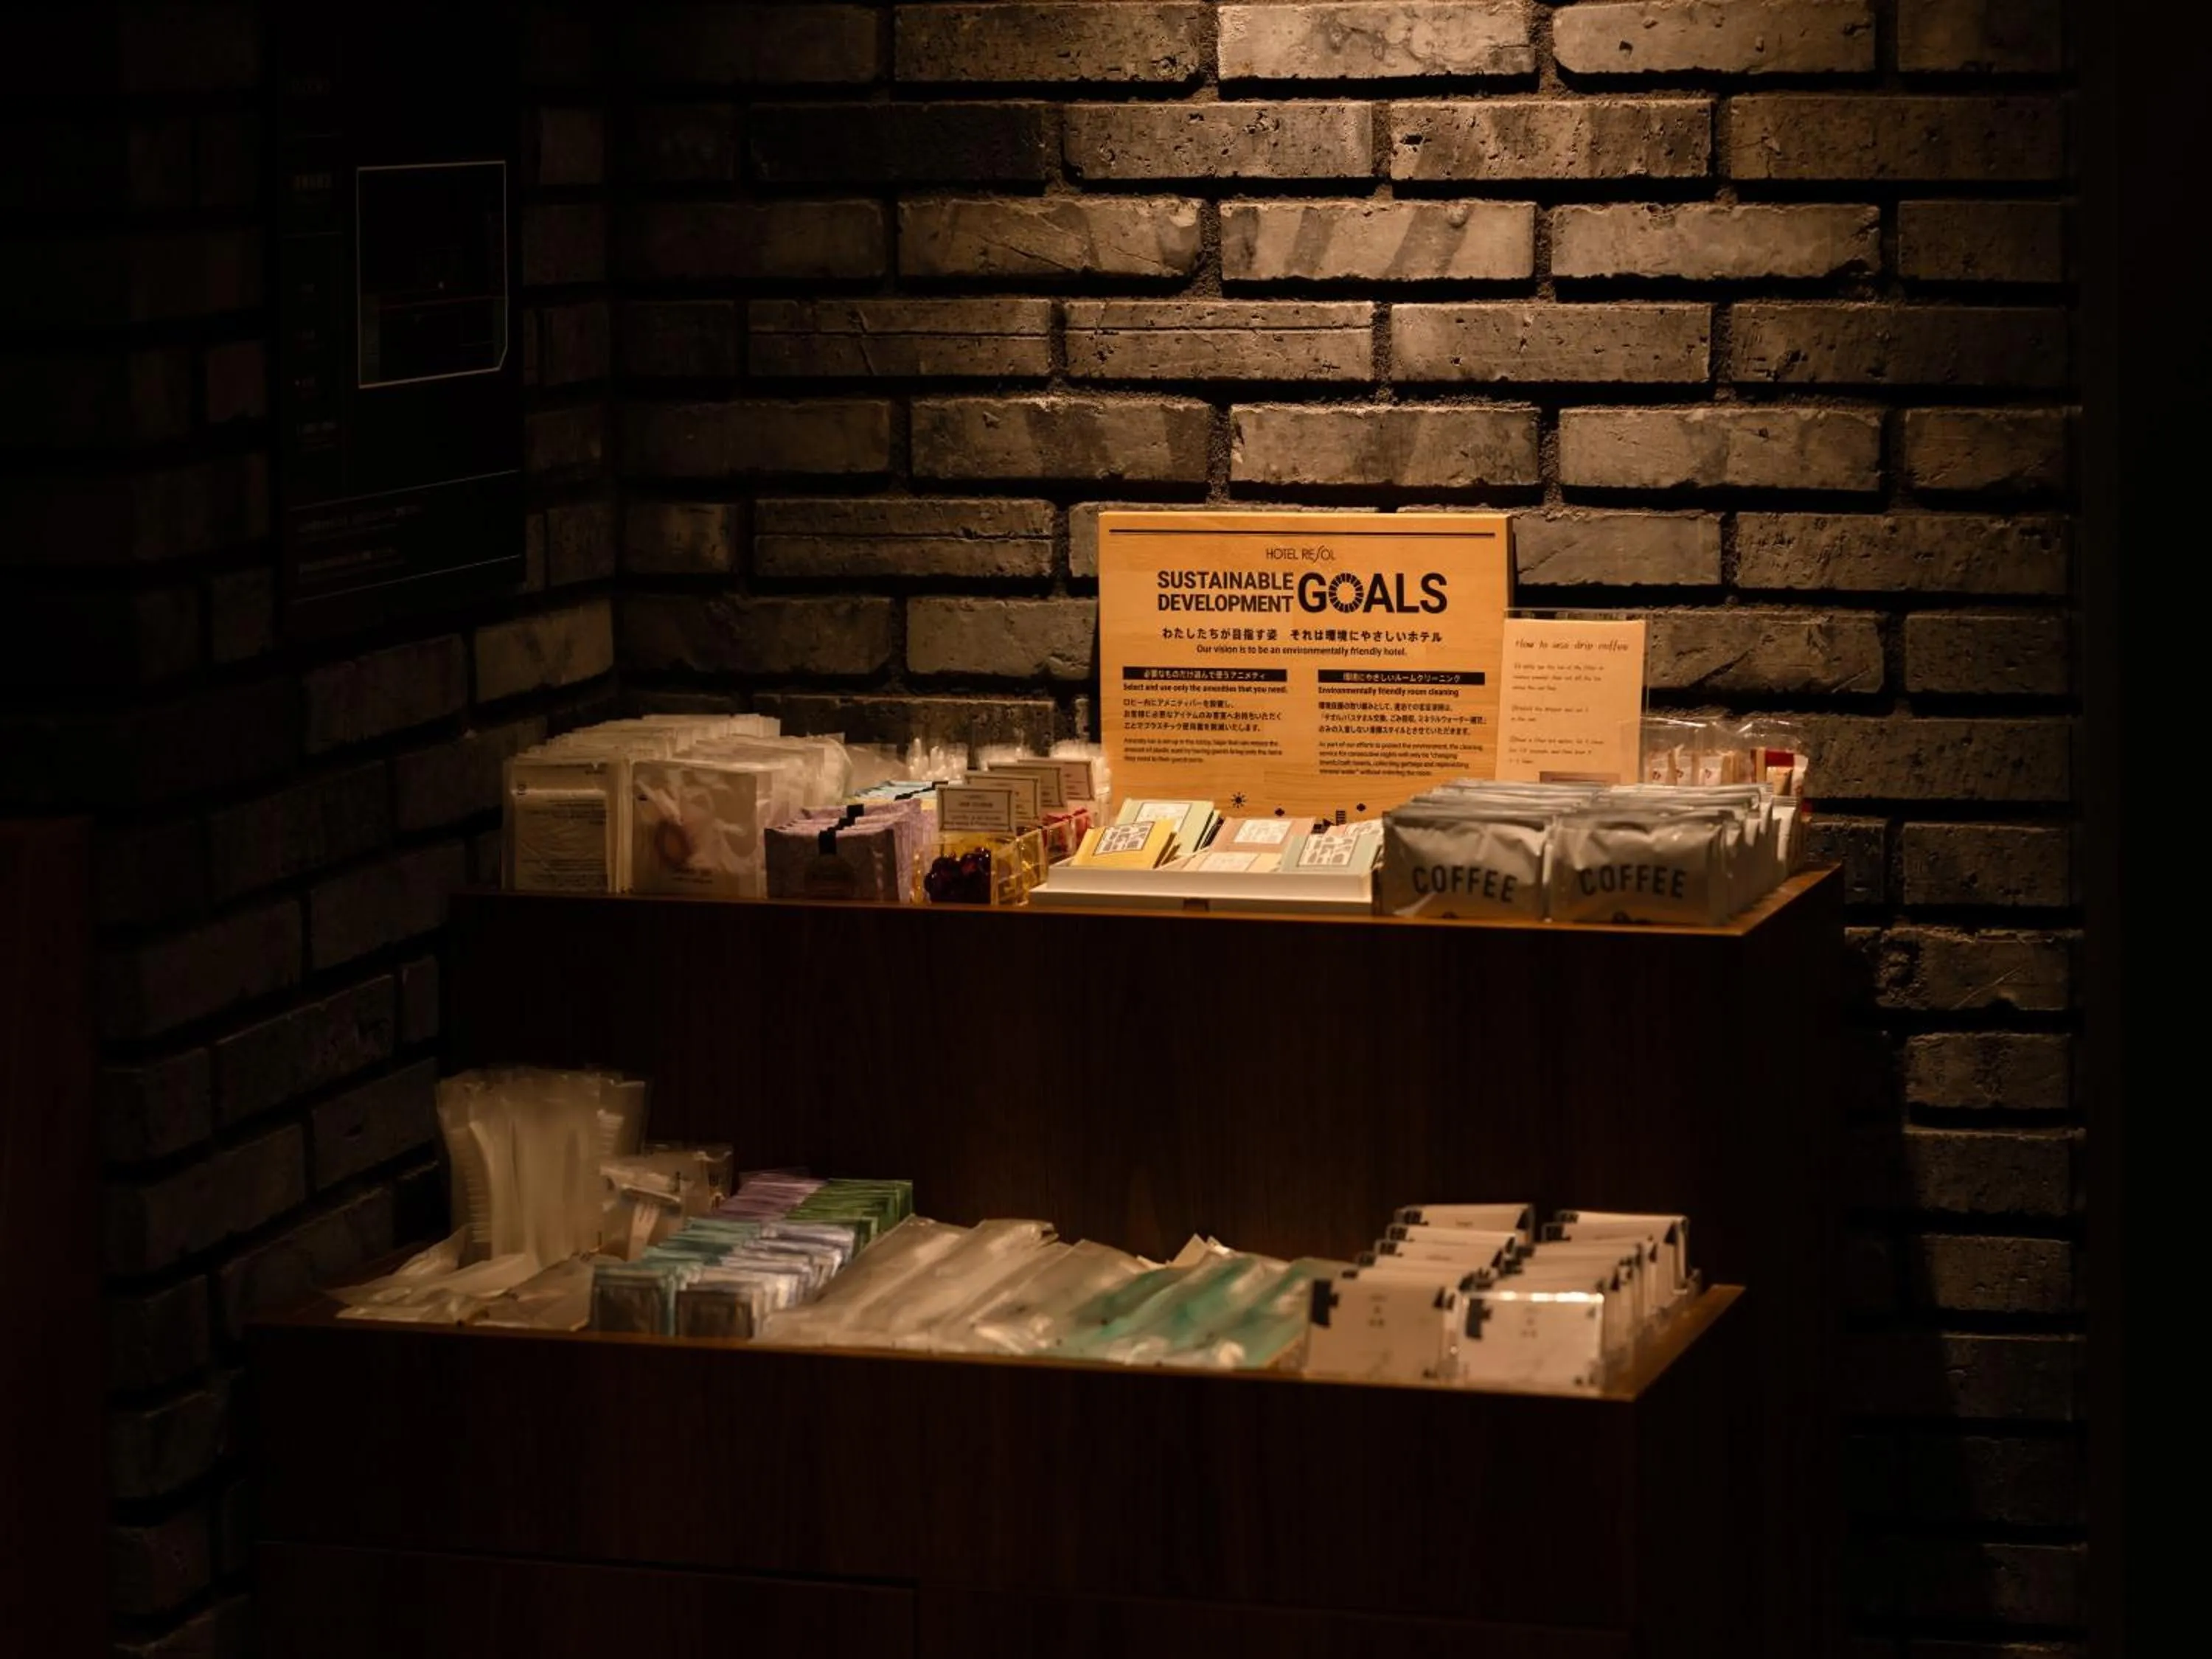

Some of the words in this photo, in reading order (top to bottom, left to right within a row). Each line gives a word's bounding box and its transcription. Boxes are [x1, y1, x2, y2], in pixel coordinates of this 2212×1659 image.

[1265, 548, 1298, 560] HOTEL
[1157, 570, 1294, 591] SUSTAINABLE
[1158, 594, 1294, 613] DEVELOPMENT
[1298, 572, 1448, 613] GOALS
[1162, 627, 1278, 641] わたしたちが目指す姿
[1290, 629, 1443, 643] それは環境にやさしいホテル
[1196, 644, 1211, 653] Our
[1213, 644, 1238, 654] vision
[1239, 645, 1246, 654] is
[1248, 646, 1256, 655] to
[1258, 646, 1269, 655] be
[1350, 647, 1382, 658] friendly
[1383, 648, 1406, 656] hotel.
[1515, 638, 1534, 649] How
[1539, 639, 1548, 650] to
[1574, 640, 1594, 651] drip
[1123, 683, 1144, 691] Select
[1173, 684, 1189, 693] only
[1252, 686, 1267, 695] you
[1377, 687, 1405, 697] friendly
[1427, 689, 1459, 698] cleaning
[1412, 865, 1517, 903] COFFEE
[1578, 864, 1687, 900] COFFEE
